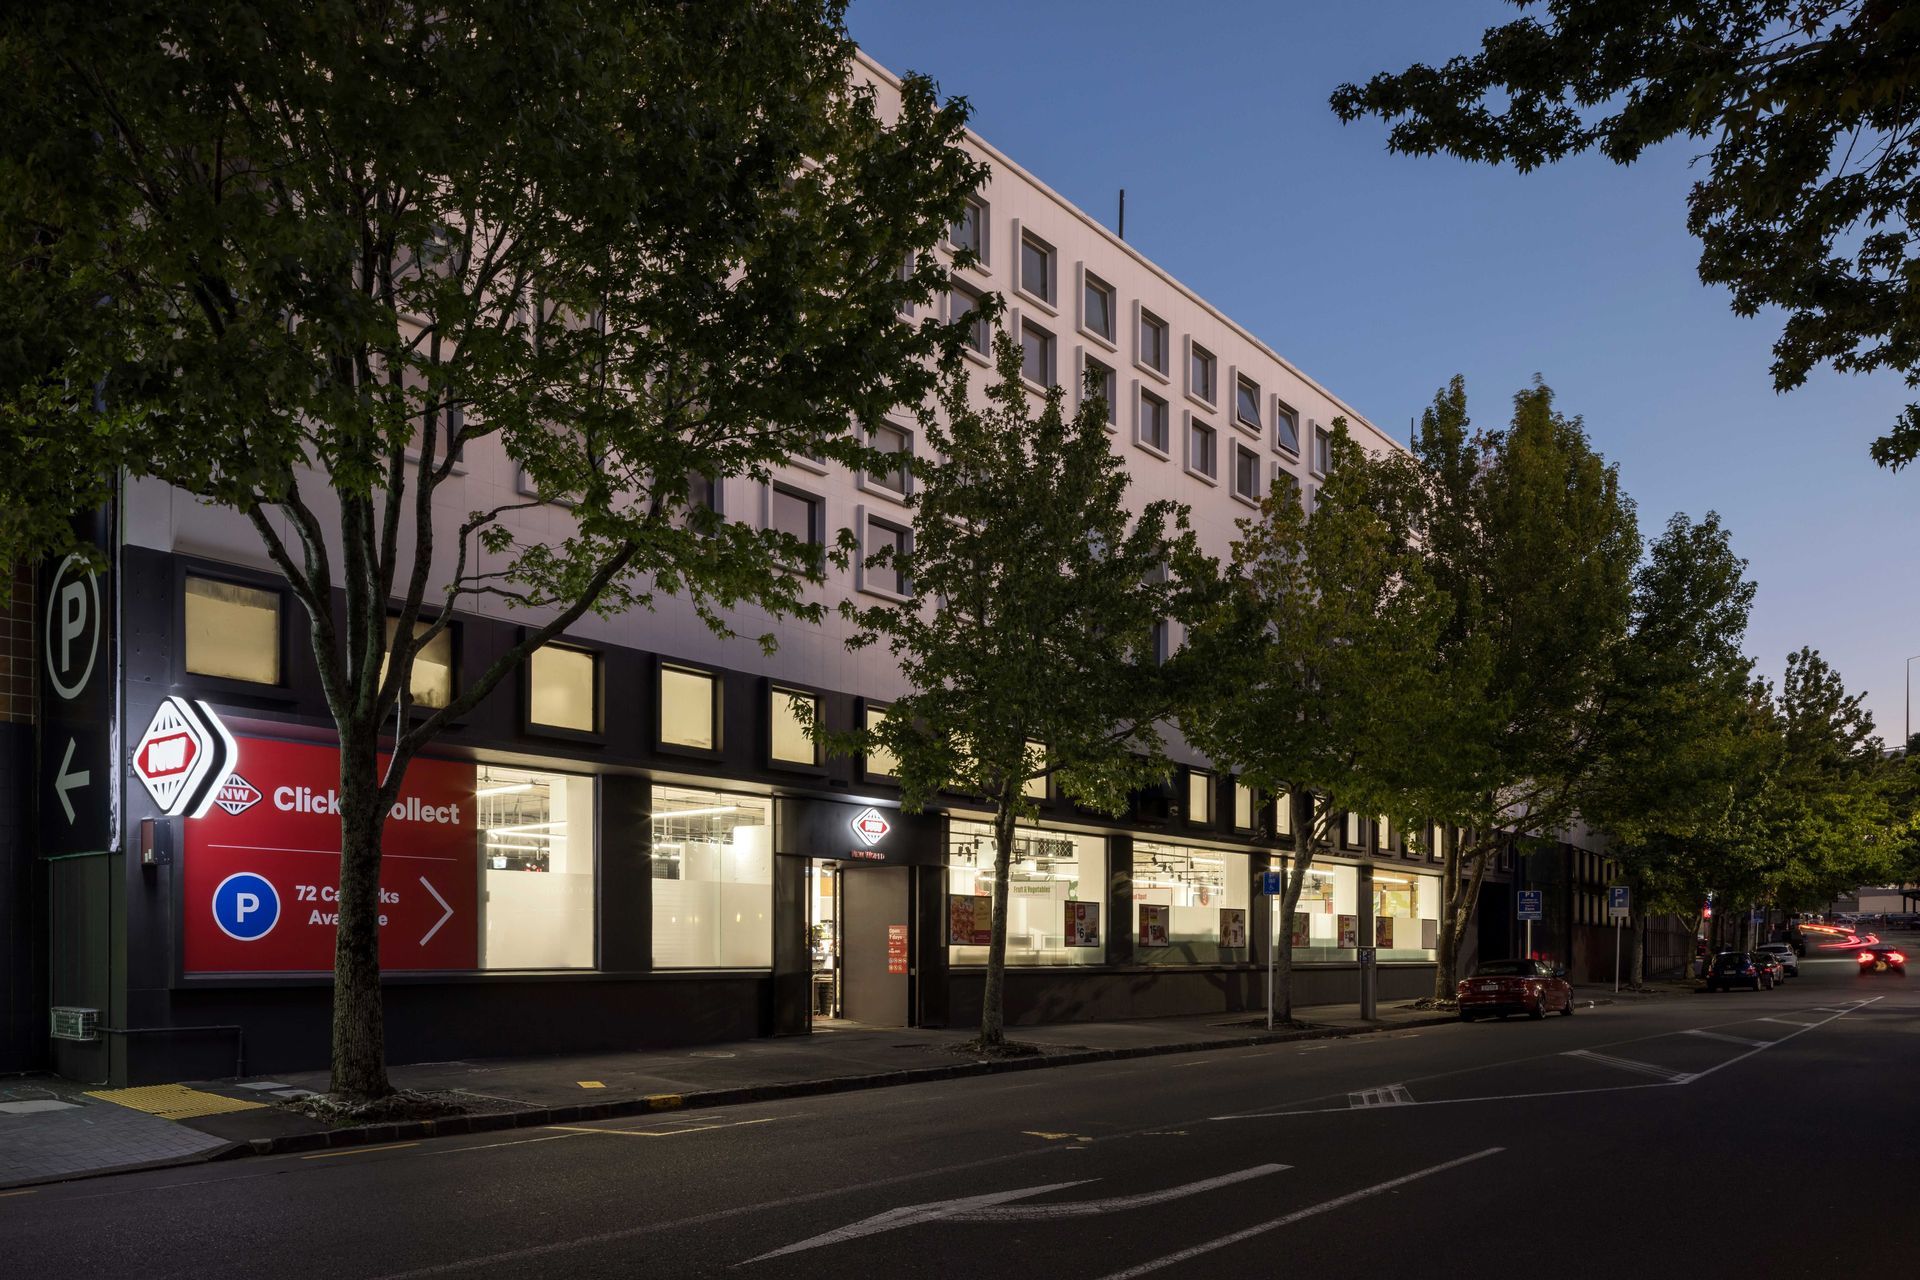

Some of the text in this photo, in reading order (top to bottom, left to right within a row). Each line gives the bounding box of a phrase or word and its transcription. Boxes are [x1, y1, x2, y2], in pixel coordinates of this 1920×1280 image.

[61, 580, 88, 673] P
[219, 787, 250, 801] NW
[273, 786, 460, 824] Click ollect
[295, 885, 317, 902] 72
[1615, 888, 1624, 897] P
[236, 892, 260, 923] P
